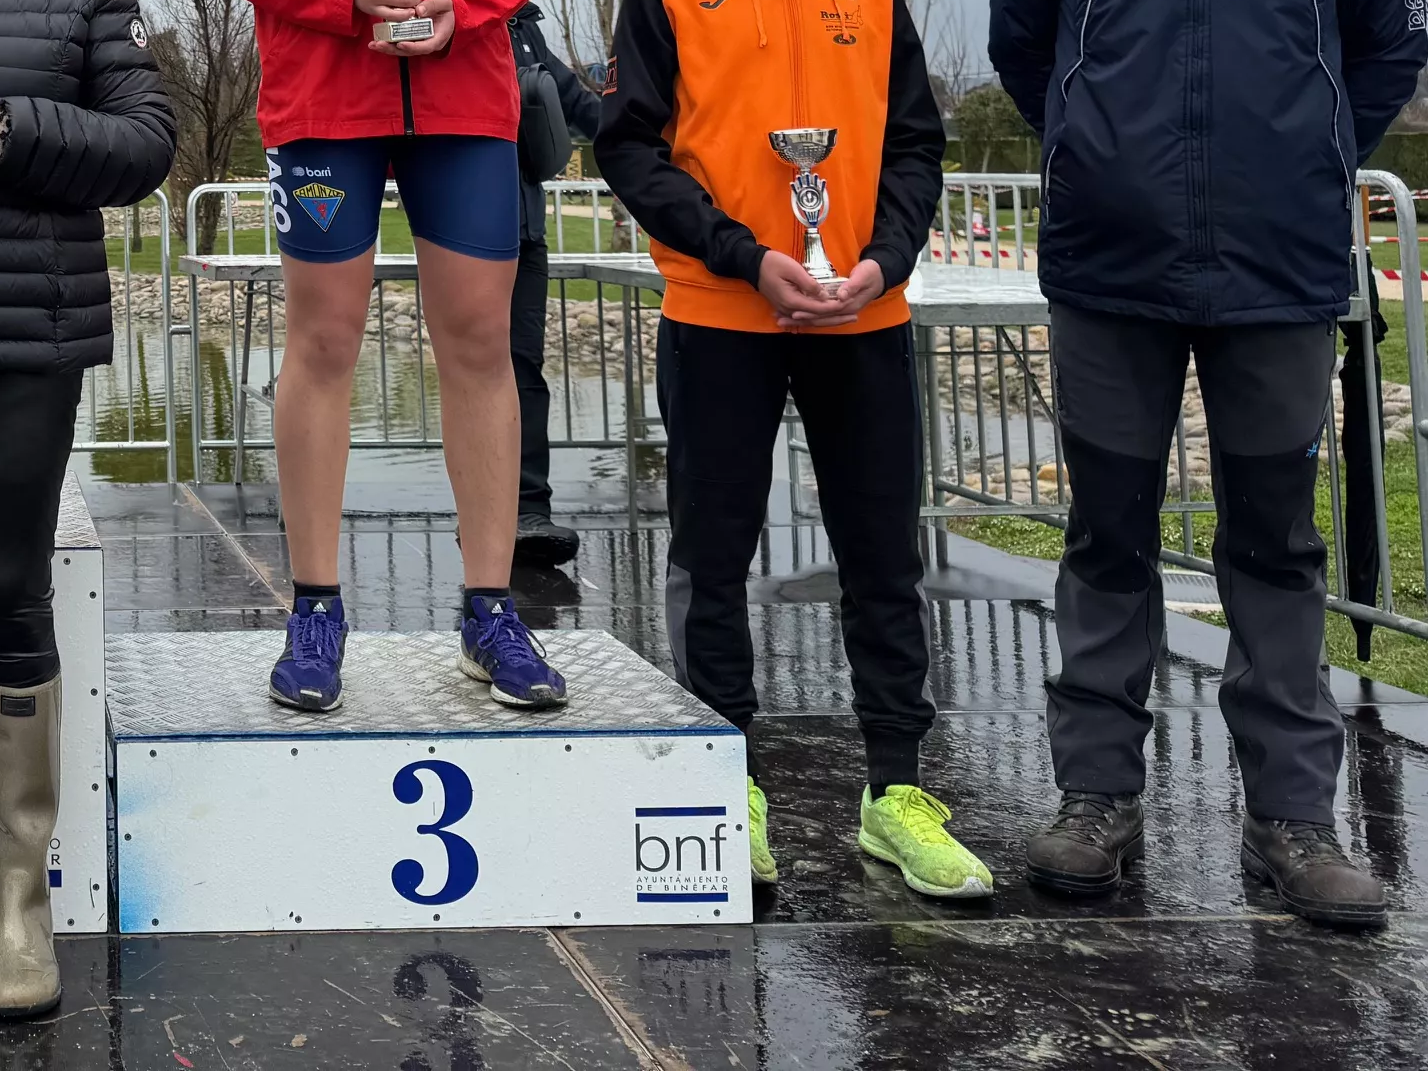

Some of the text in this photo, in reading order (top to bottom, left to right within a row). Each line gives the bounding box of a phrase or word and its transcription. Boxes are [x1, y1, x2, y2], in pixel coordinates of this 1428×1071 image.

[266, 147, 292, 233] ACO
[305, 166, 331, 177] barri
[391, 760, 479, 905] 3
[635, 823, 727, 873] bnf
